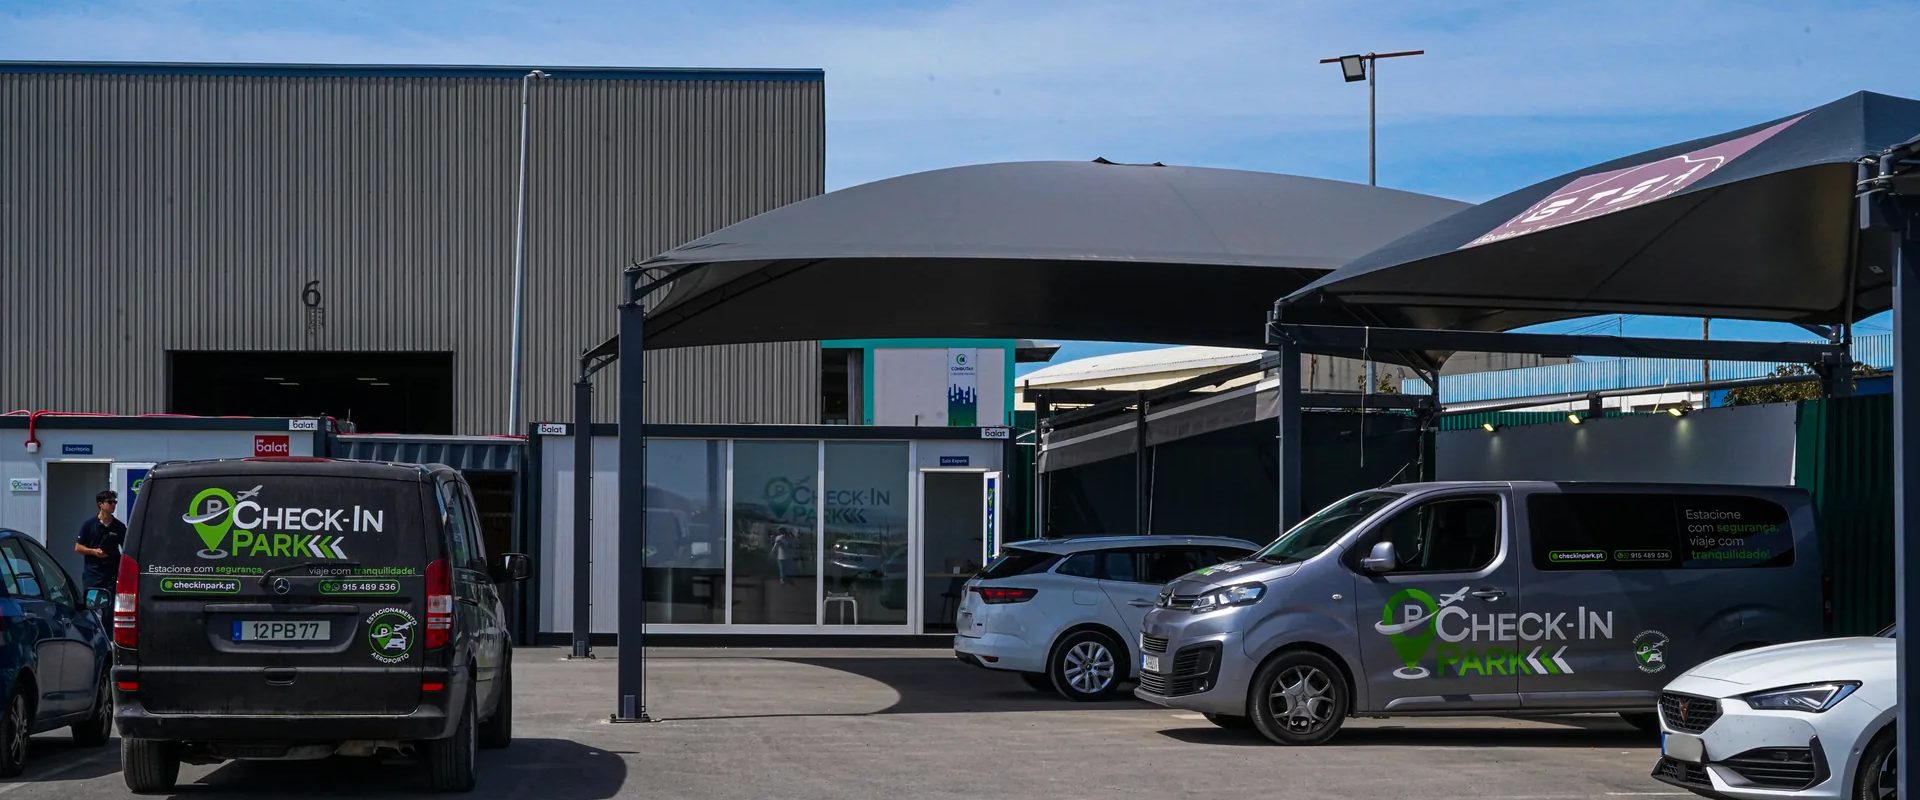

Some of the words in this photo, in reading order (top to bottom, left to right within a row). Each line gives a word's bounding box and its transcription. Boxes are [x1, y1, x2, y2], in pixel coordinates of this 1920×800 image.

[302, 280, 321, 307] 6
[293, 420, 314, 429] balat
[541, 424, 563, 433] balat
[985, 428, 1006, 437] balat
[256, 439, 288, 452] balat
[233, 500, 384, 533] CHECK-IN
[1685, 509, 1741, 520] Estacione
[1688, 524, 1714, 533] com
[232, 529, 313, 558] PARK
[1689, 536, 1716, 548] viaje
[1718, 537, 1744, 546] com
[1558, 552, 1604, 561] checkinpark.pt
[149, 564, 192, 573] Estacione
[309, 567, 329, 577] viaje
[354, 566, 416, 576] tranquilidade!
[173, 580, 235, 591] checkinpark.pt
[342, 583, 357, 591] 915
[359, 583, 377, 591] 489
[379, 583, 396, 591] 536
[366, 607, 418, 626] ESTACIONAMENTO
[1435, 605, 1613, 643] CHECK-IN
[371, 652, 410, 664] AEROPORTO
[1436, 643, 1532, 677] PARK
